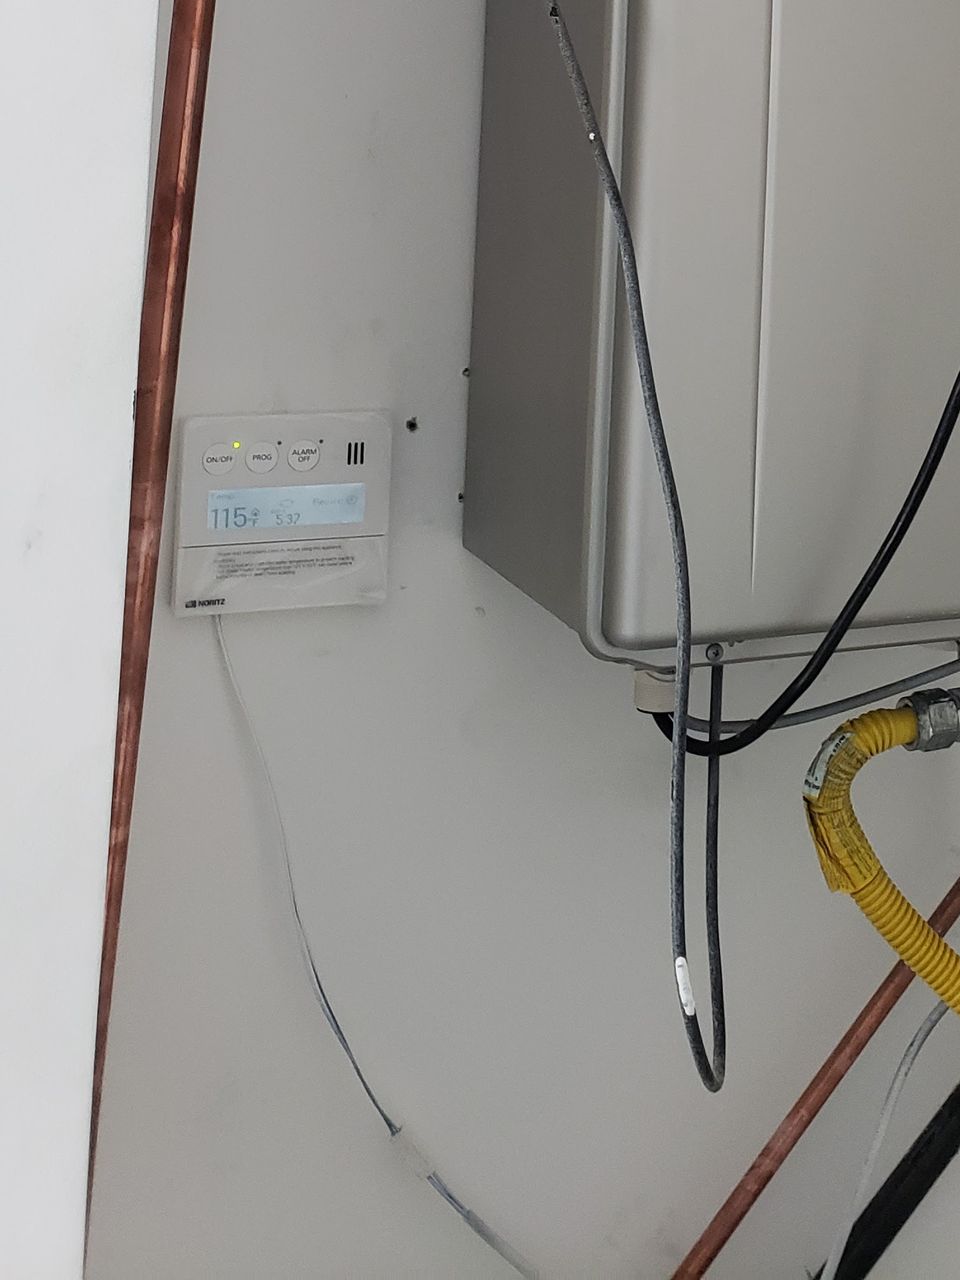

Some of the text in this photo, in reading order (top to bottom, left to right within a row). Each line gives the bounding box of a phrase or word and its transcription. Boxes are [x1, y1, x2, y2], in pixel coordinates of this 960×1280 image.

[291, 448, 318, 456] ALARM
[205, 455, 233, 464] ON/OFF
[252, 453, 273, 462] PROG
[297, 455, 311, 463] OFF
[210, 507, 247, 529] 115
[198, 598, 225, 607] NORITZ
